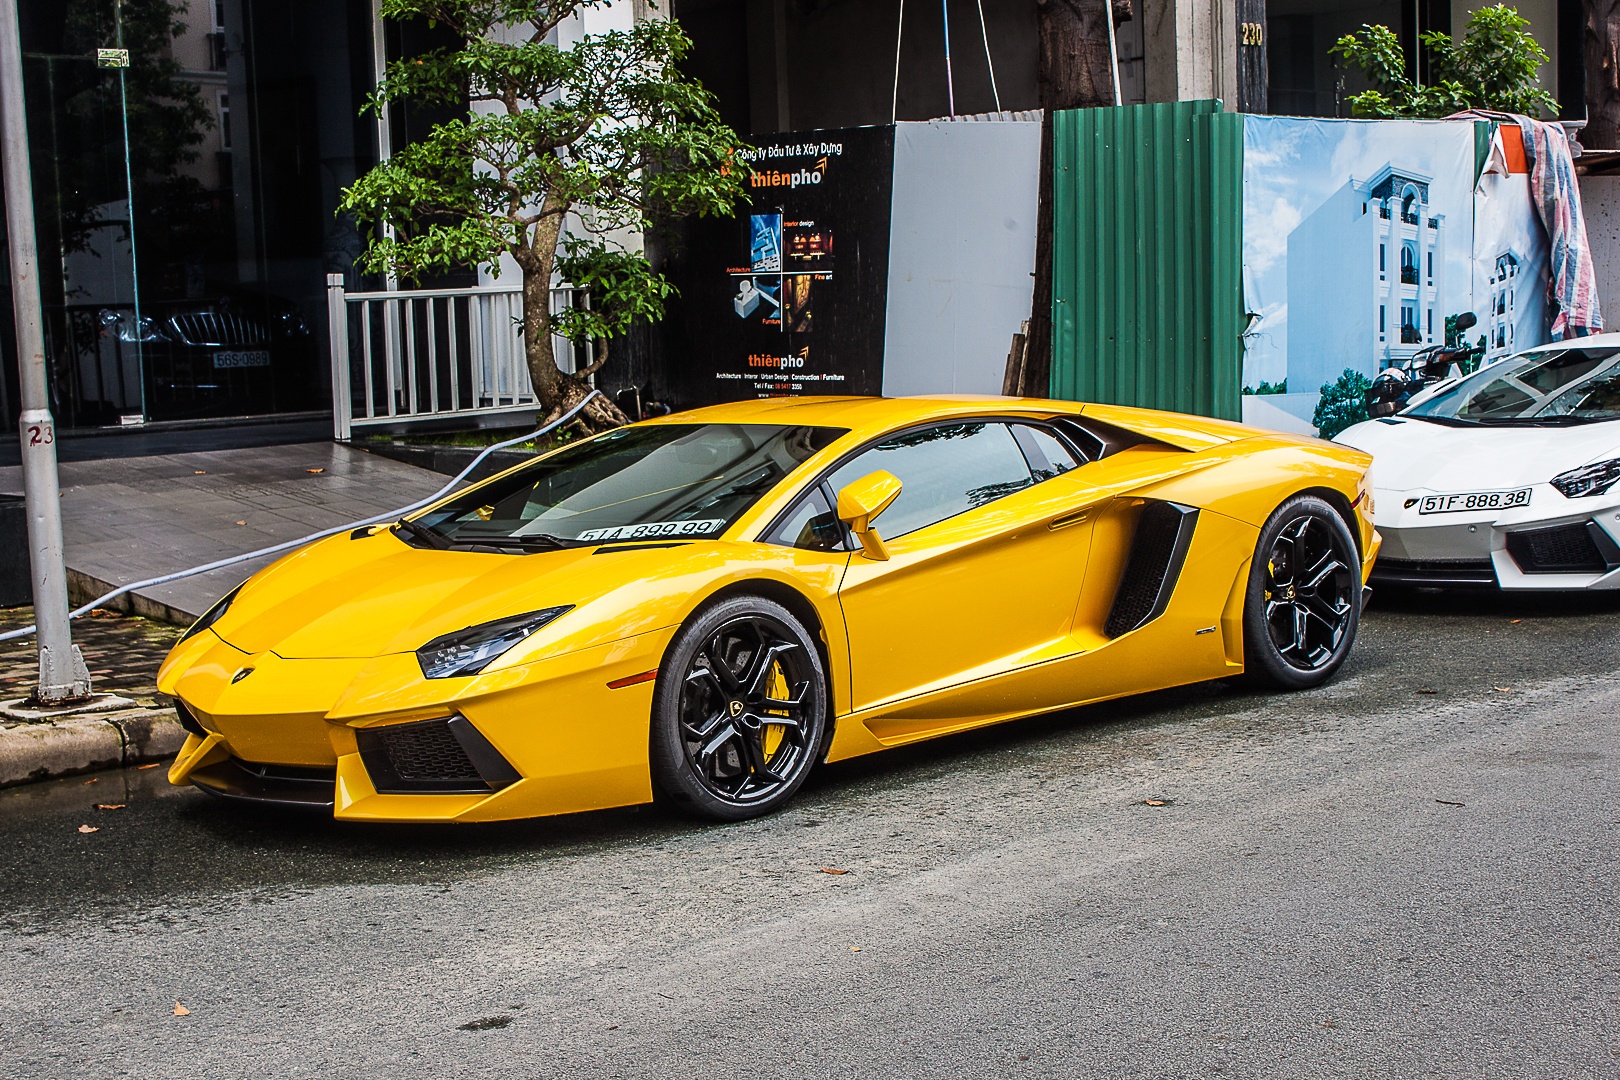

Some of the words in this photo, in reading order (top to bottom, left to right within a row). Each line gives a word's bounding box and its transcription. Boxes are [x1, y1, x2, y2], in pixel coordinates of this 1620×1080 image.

[1242, 22, 1262, 46] 230
[758, 147, 767, 160] Ty
[768, 144, 785, 158] Đầu
[785, 144, 795, 157] Tư
[795, 144, 802, 155] &
[803, 143, 820, 157] Xây
[820, 142, 843, 157] Dựng
[27, 425, 54, 447] 23
[1425, 490, 1527, 511] 51F-888.38
